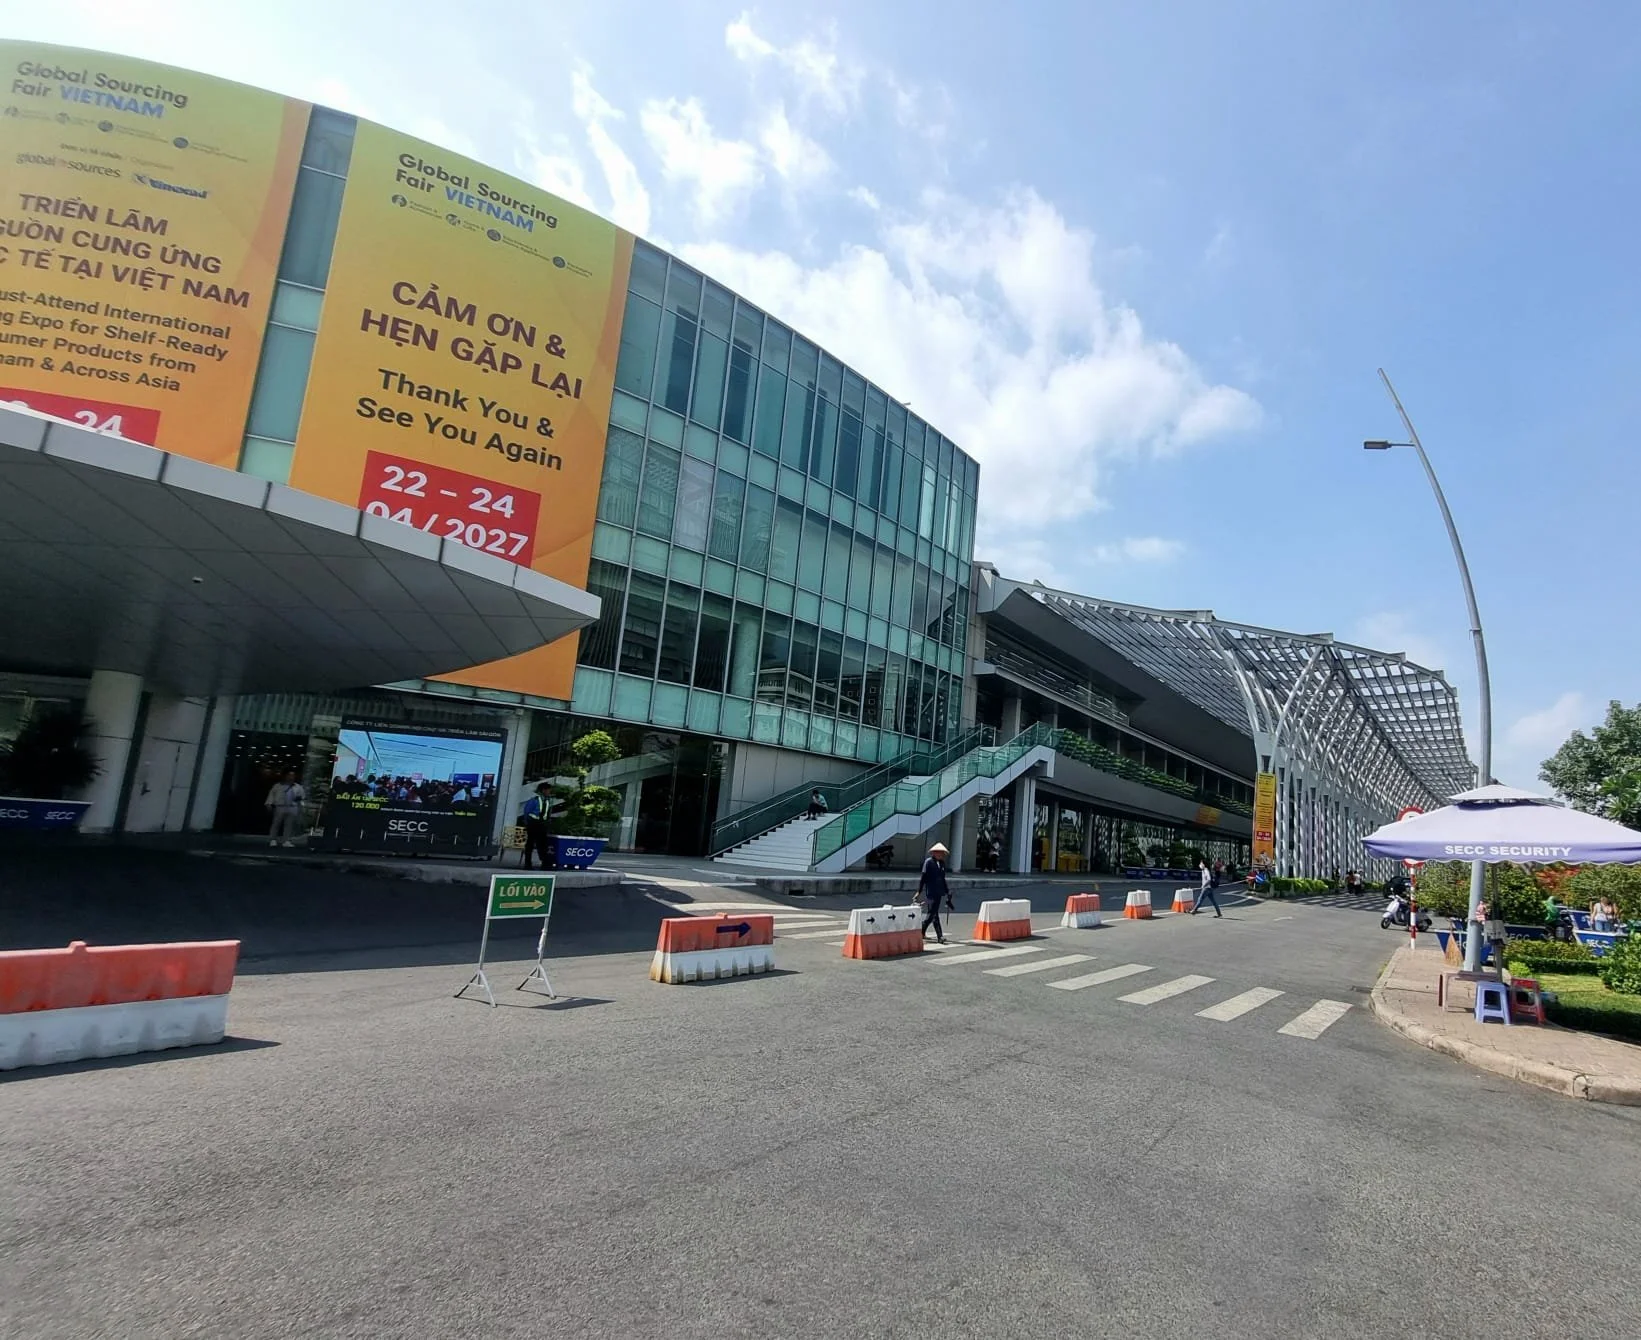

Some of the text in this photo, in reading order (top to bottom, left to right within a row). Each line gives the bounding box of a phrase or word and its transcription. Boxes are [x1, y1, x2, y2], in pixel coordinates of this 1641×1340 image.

[11, 79, 52, 97] Fair
[59, 85, 165, 119] VIETNAM
[17, 61, 189, 109] Global Sourcing
[67, 160, 122, 178] sources
[395, 168, 436, 194] Fair
[444, 186, 535, 234] VIETNAM
[399, 153, 470, 190] Global
[477, 182, 559, 230] Sourcing
[19, 193, 169, 236] TRIỂN LÃM
[71, 229, 152, 260] CUNG
[160, 243, 223, 274] ỨNG
[18, 247, 55, 270] TẾ
[58, 254, 103, 280] TẠI
[112, 263, 176, 291] VIỆT
[182, 278, 251, 308] NAM
[19, 311, 64, 333] Expo
[70, 318, 99, 337] for
[103, 304, 231, 341] International
[392, 281, 567, 360] CẢM ƠN &
[53, 338, 144, 366] Products
[149, 352, 197, 374] from
[360, 308, 584, 400] HẸN GẶP LẠI
[40, 356, 55, 372] &
[60, 360, 131, 384] Across
[135, 372, 182, 393] Asia
[378, 368, 555, 439] Thank You &
[355, 397, 564, 472] See You Again
[380, 465, 429, 499] 22
[468, 487, 516, 519] 24
[444, 518, 530, 557] 2027
[43, 811, 77, 821] SECC
[388, 819, 429, 833] SECC
[565, 847, 594, 858] SECC
[1445, 845, 1572, 857] SECC SECURITY
[499, 881, 546, 897] LỐI VÀO
